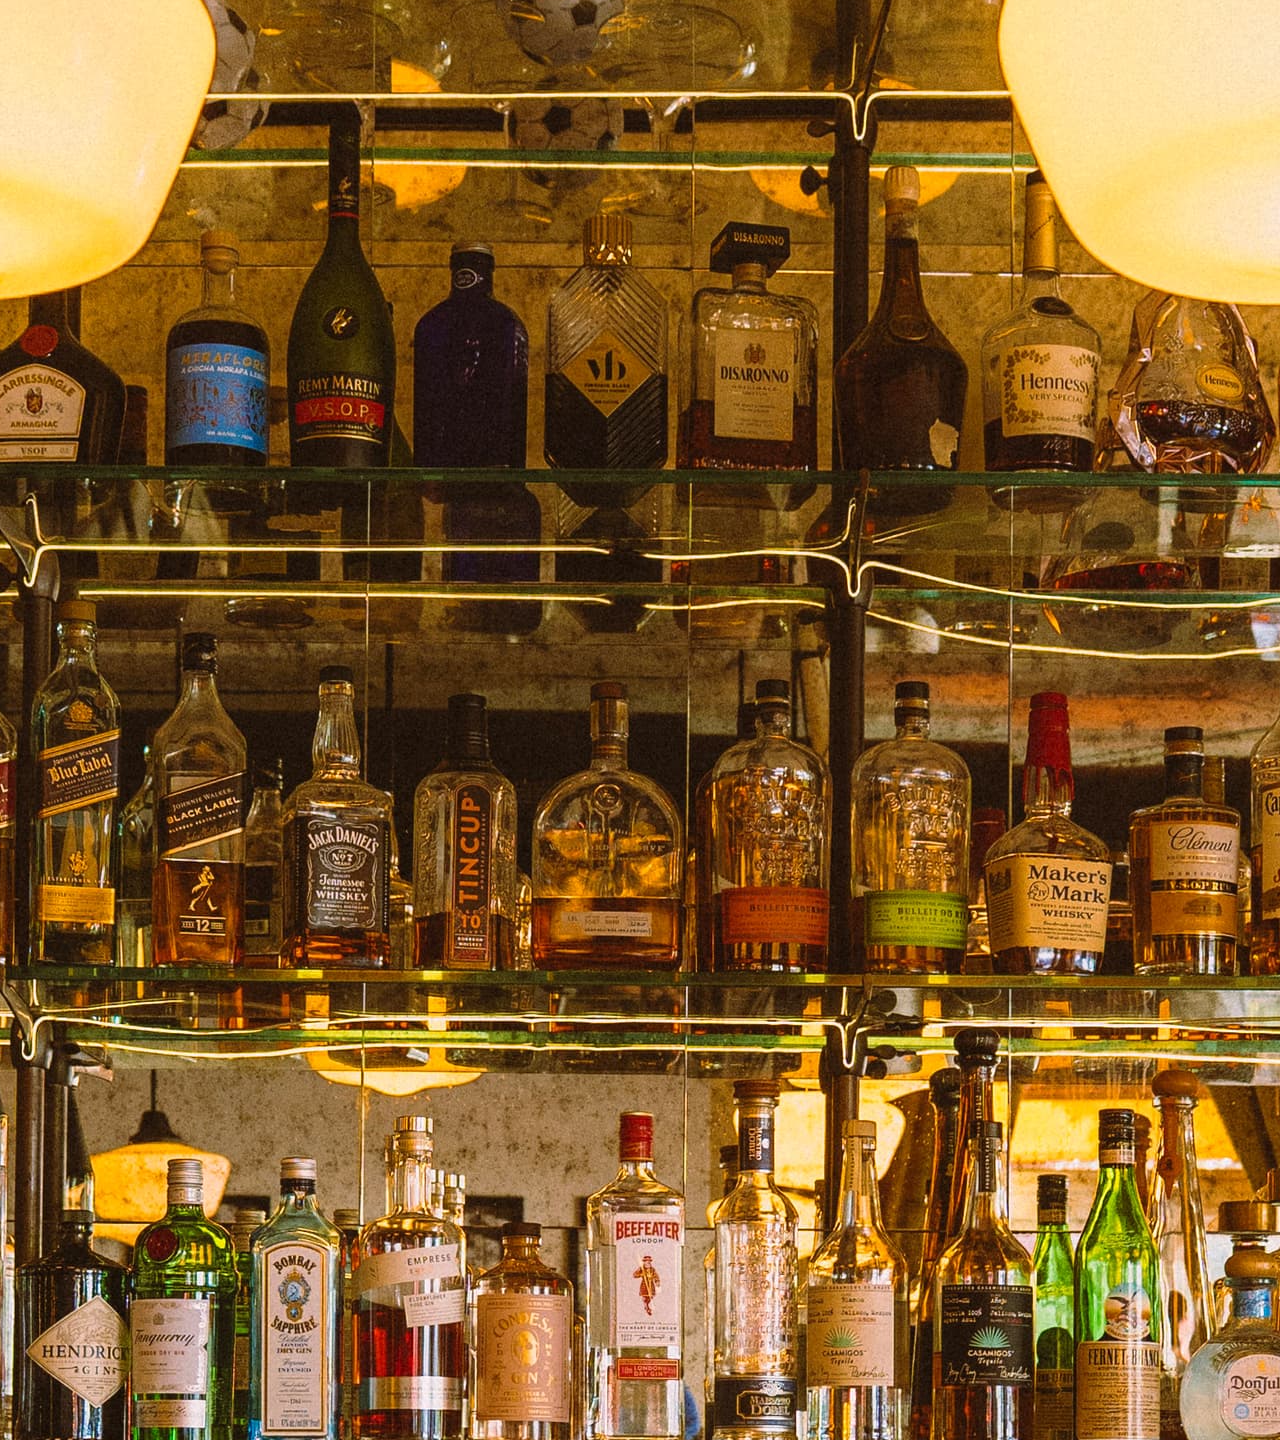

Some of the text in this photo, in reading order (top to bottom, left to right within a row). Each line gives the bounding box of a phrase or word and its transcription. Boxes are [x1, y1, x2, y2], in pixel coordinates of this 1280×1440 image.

[733, 231, 785, 246] DISARONNO
[720, 366, 789, 384] DISARONNO
[331, 375, 380, 394] MARTIN
[1020, 373, 1091, 397] Hennessy
[1028, 392, 1084, 404] VERY SPECIAL
[10, 420, 59, 429] ARMAGNAC
[20, 447, 48, 456] VSOP
[47, 752, 113, 785] Blue Label
[172, 786, 235, 813] JOHNNIE WALKER
[166, 796, 241, 826] BLACK LABEL
[307, 826, 381, 855] JACK DANIEL'S
[1168, 826, 1234, 853] Clément
[458, 796, 481, 904] TINCUP
[319, 873, 366, 888] Tennessee
[1027, 864, 1108, 885] Maker's
[315, 890, 369, 902] WHISKEY
[1050, 884, 1107, 904] Mark
[749, 903, 792, 913] BULLEIT
[897, 906, 953, 919] BULLEIT 95
[1042, 910, 1095, 920] WHISKY
[195, 919, 210, 933] 12
[461, 915, 482, 929] 10
[748, 1127, 756, 1161] DOBEL
[616, 1220, 680, 1241] BEEFEATER
[273, 1255, 318, 1274] BOMBAY
[407, 1253, 452, 1266] EMPRESS
[270, 1316, 319, 1335] SAPPHIRE
[135, 1329, 195, 1347] Tanqueray
[822, 1349, 864, 1357] CASAMIGOS
[967, 1348, 1013, 1358] CASAMIGOS
[831, 1357, 854, 1365] Tequila
[977, 1357, 1004, 1366] Tequila
[82, 1366, 112, 1375] GIN
[510, 1372, 538, 1386] GIN
[1231, 1375, 1260, 1390] Don
[750, 1404, 791, 1417] DOBEL
